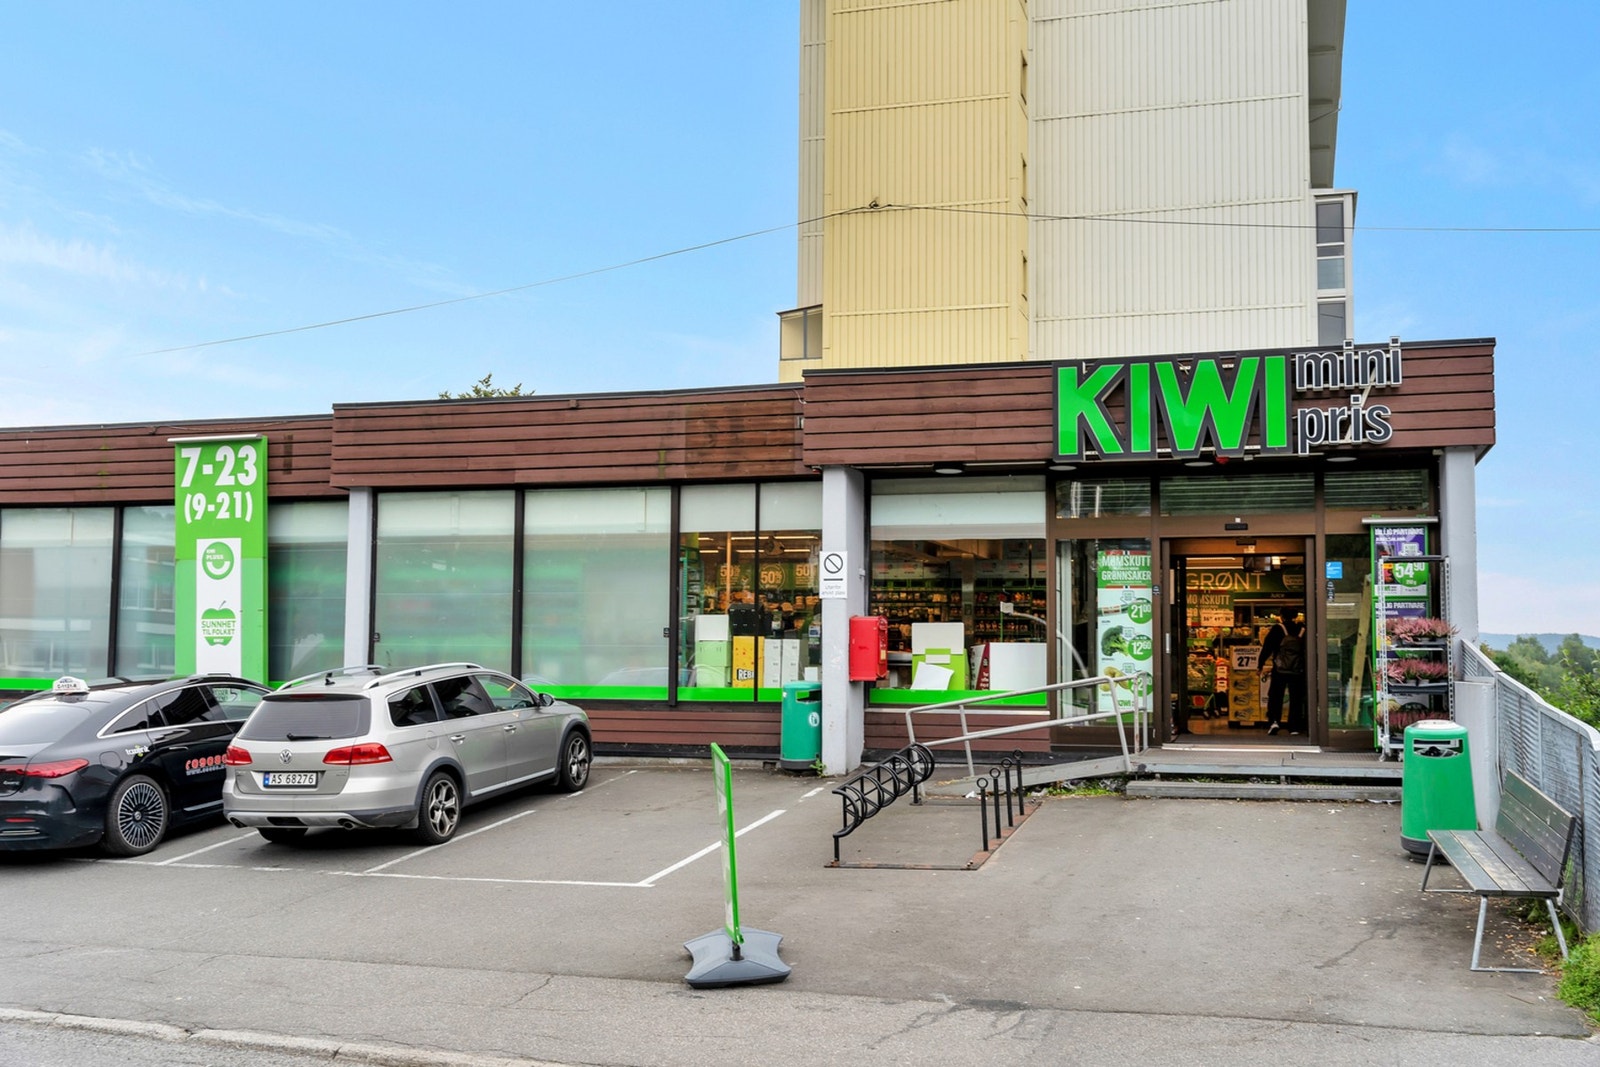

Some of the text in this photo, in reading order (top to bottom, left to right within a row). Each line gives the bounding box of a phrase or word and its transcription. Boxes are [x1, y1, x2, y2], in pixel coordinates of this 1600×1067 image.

[1296, 336, 1402, 391] mini
[1055, 354, 1290, 459] KIWI
[1297, 394, 1394, 456] pris
[180, 445, 258, 488] 7-23
[184, 491, 253, 525] (9-21)
[1102, 555, 1151, 566] MOMSKUTT
[1186, 572, 1266, 590] GRØNT
[201, 620, 236, 629] SUNNHET
[271, 774, 314, 785] AS 68276
